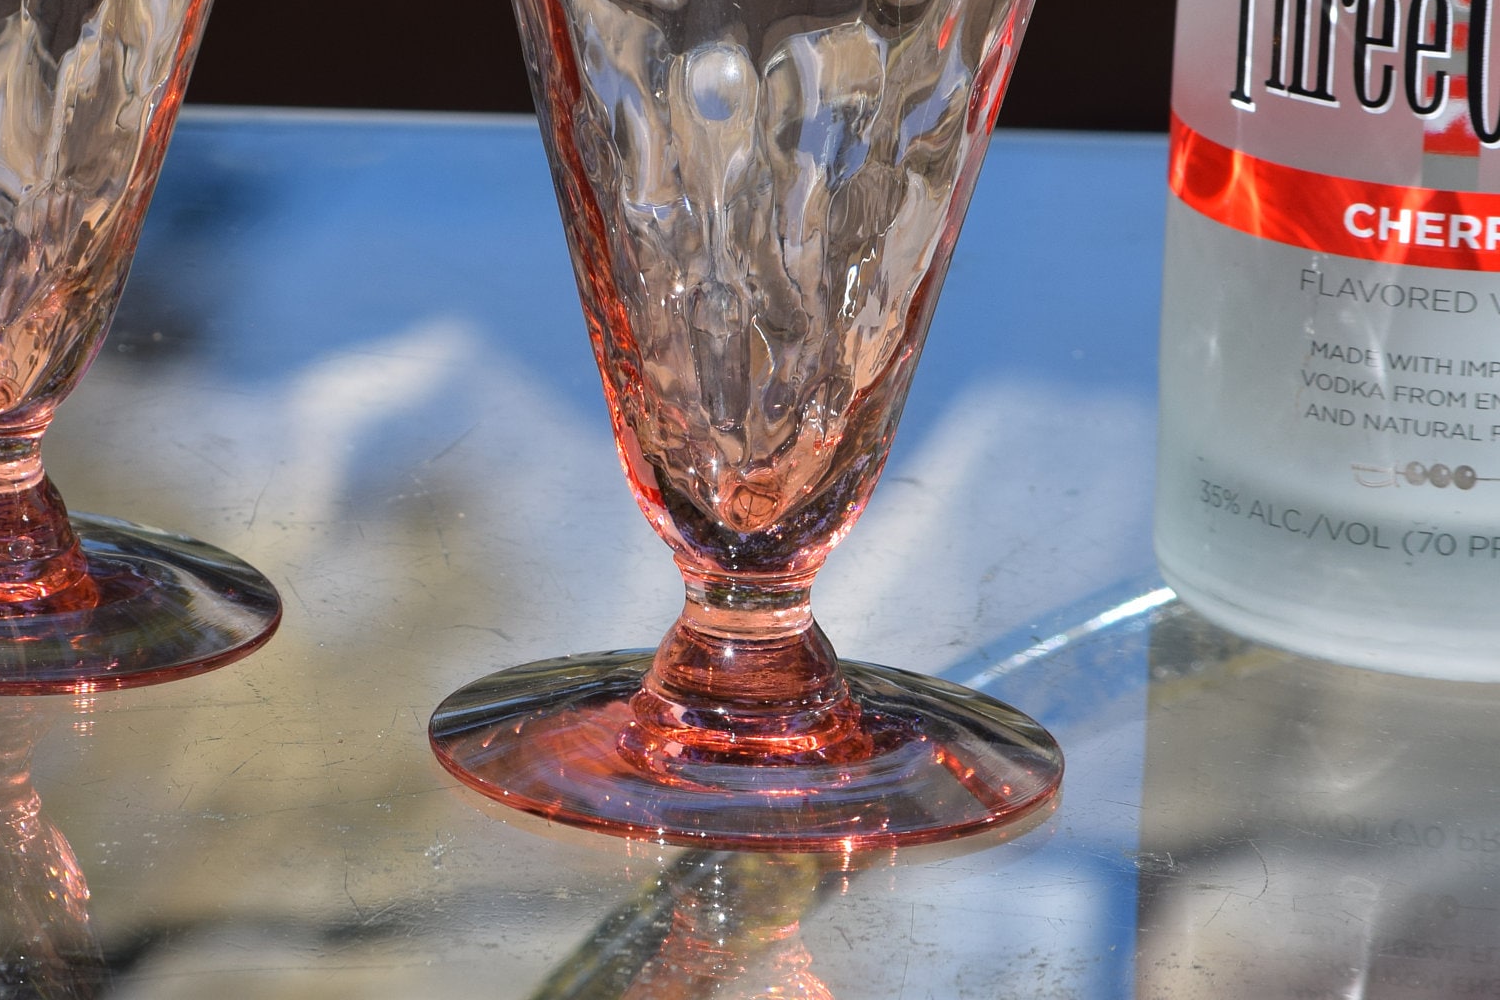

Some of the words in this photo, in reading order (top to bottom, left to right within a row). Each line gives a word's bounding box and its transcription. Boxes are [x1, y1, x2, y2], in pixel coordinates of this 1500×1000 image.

[1300, 269, 1478, 314] FLAVORED
[1310, 340, 1381, 368] MADE
[1386, 352, 1453, 376] WITH
[1300, 369, 1386, 401] VODKA
[1393, 385, 1467, 408] FROM
[1304, 403, 1356, 426] AND
[1363, 413, 1483, 441] NATURAL
[1199, 479, 1241, 515] 35%
[1402, 530, 1457, 557] (70
